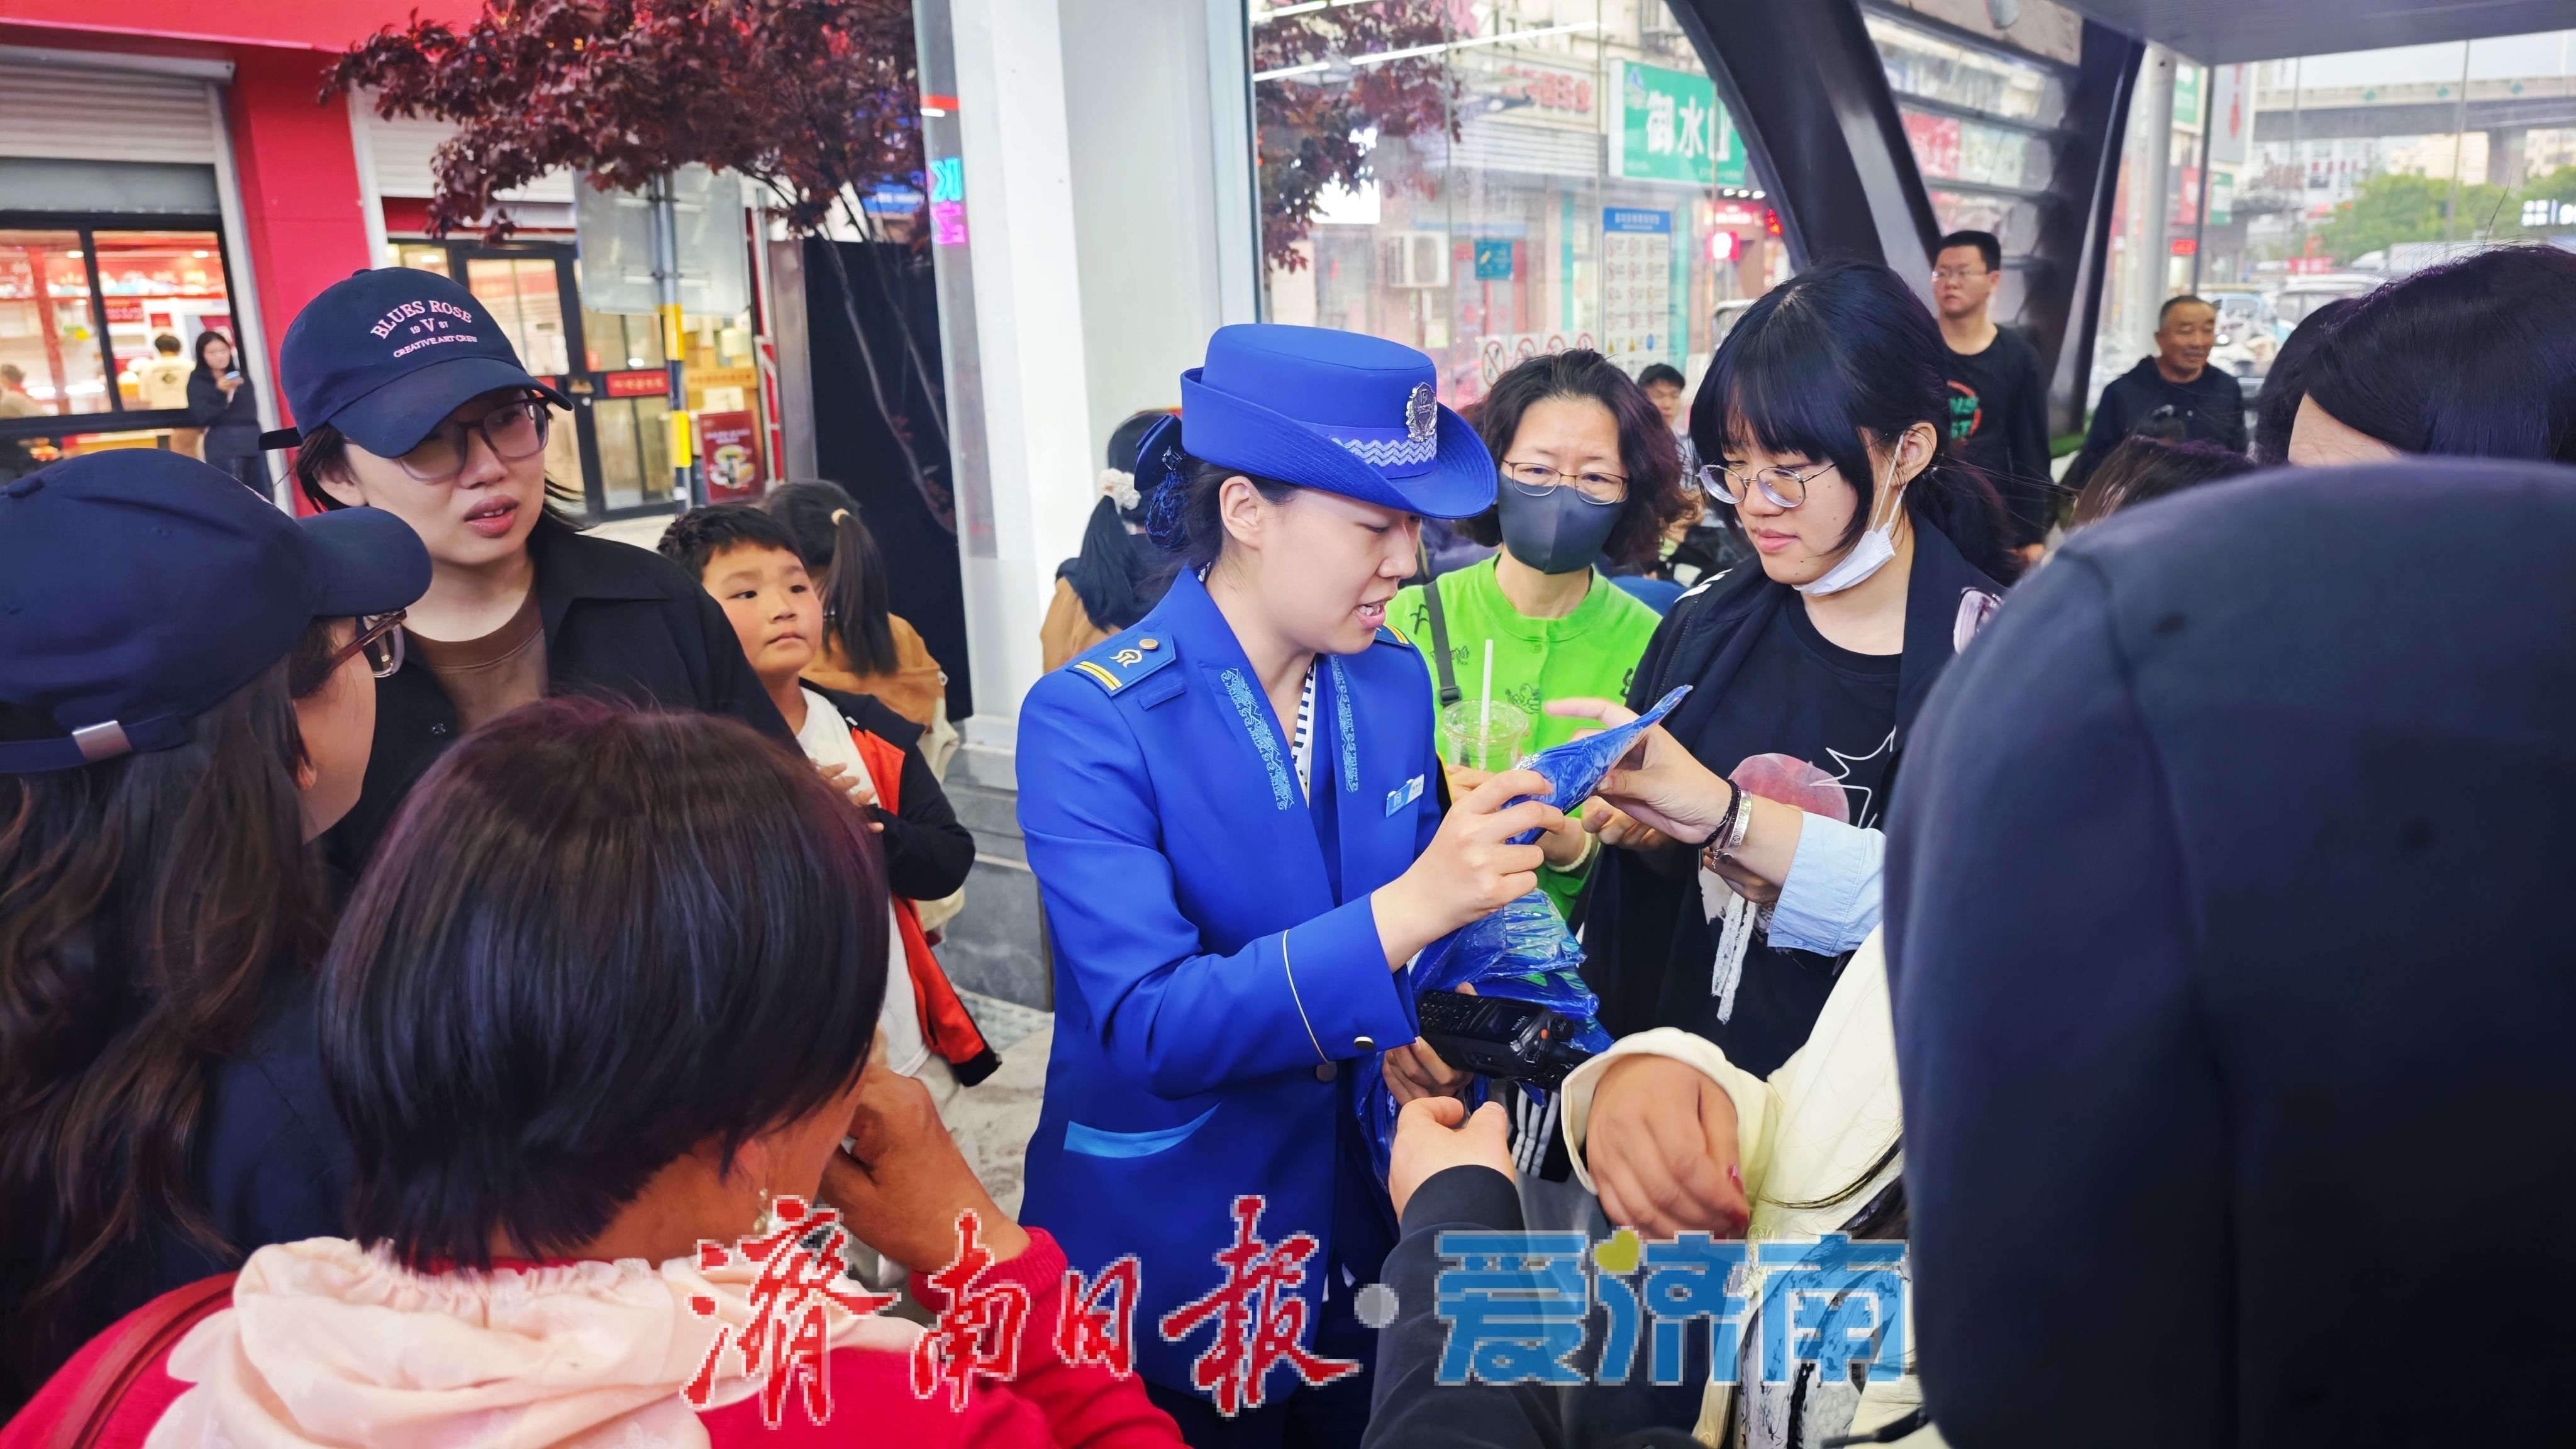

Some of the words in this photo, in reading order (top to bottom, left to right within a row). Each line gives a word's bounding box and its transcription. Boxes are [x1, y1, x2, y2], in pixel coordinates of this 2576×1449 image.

[370, 300, 426, 340] BLUES
[428, 299, 472, 323] ROSE
[419, 318, 435, 332] V
[393, 337, 438, 358] CREATIVE
[437, 335, 455, 344] ART
[455, 335, 478, 343] CREW
